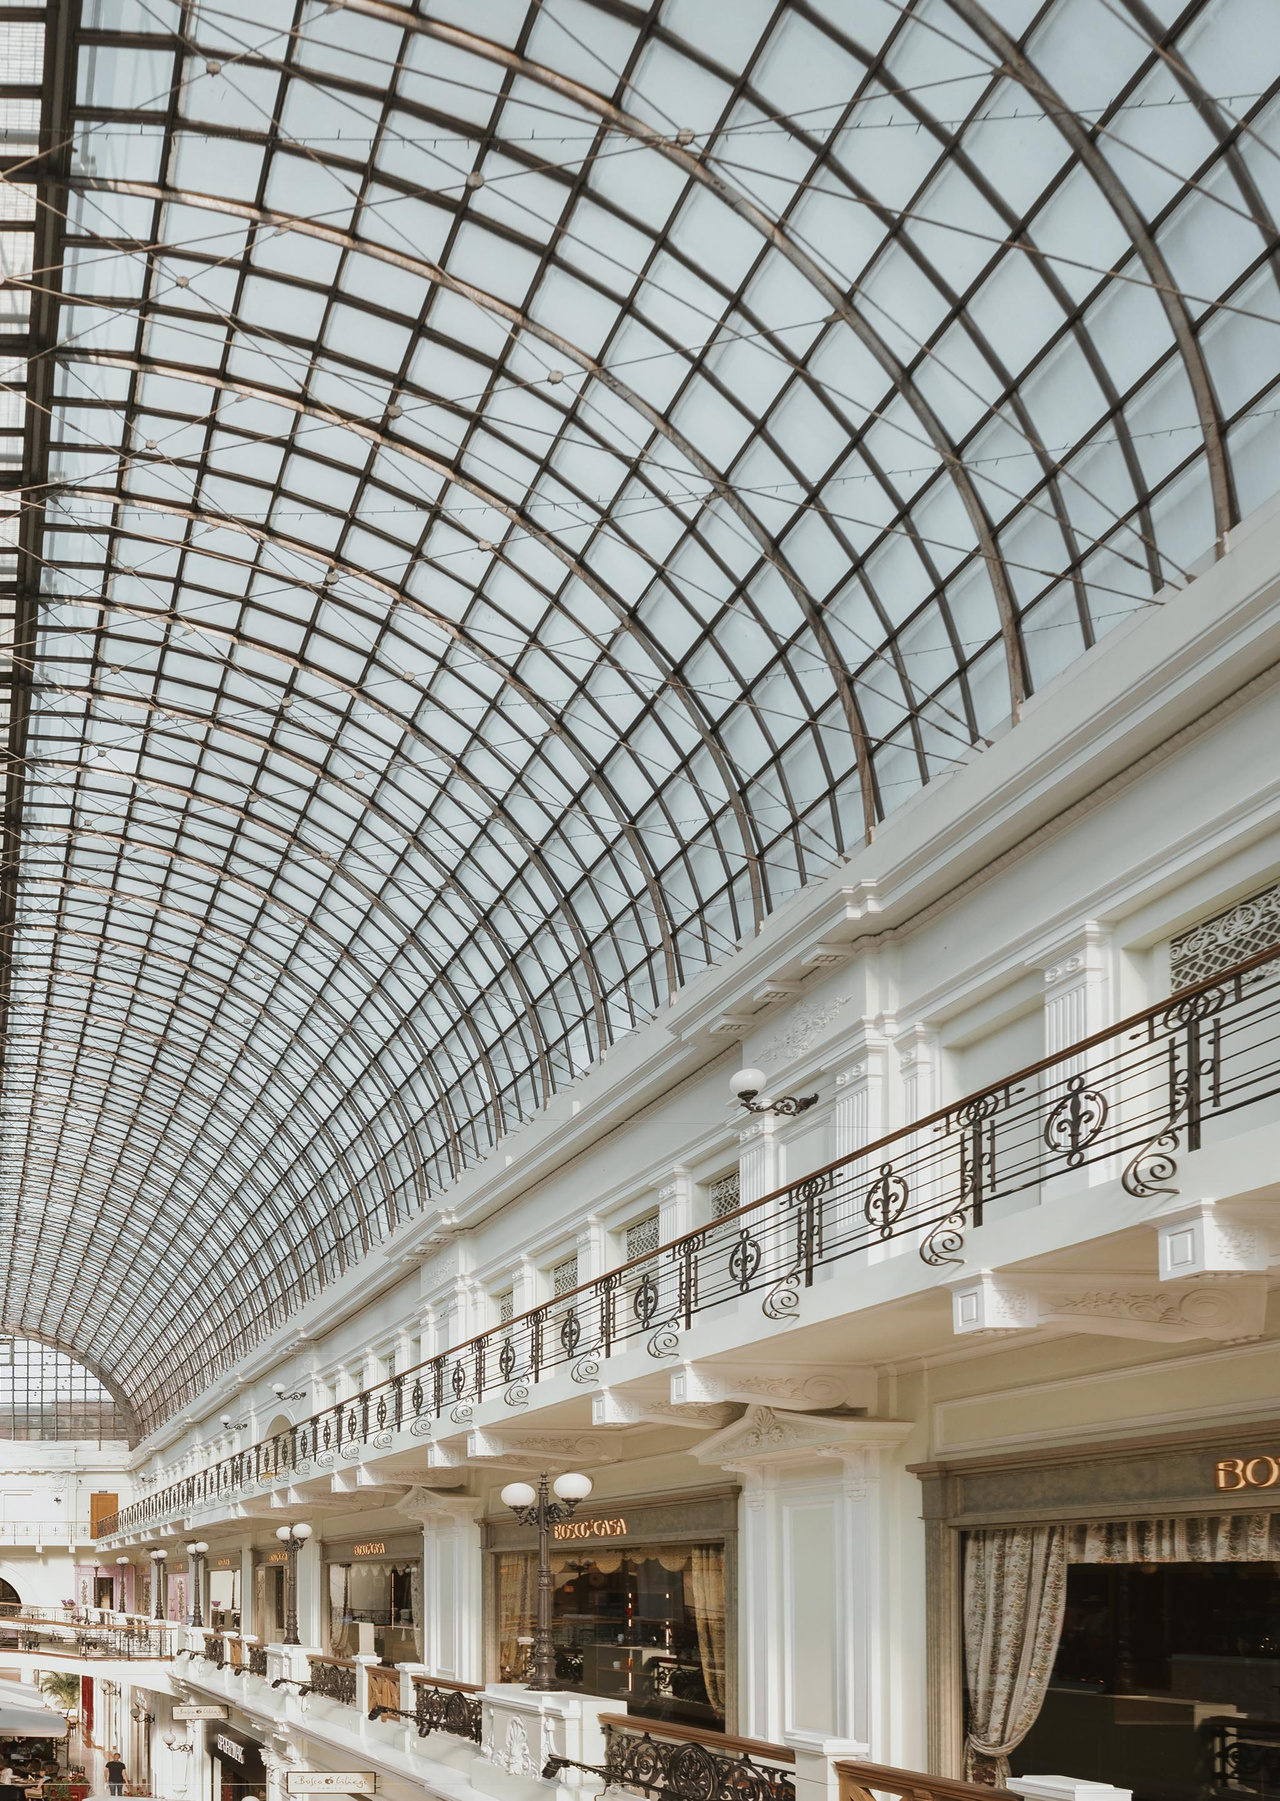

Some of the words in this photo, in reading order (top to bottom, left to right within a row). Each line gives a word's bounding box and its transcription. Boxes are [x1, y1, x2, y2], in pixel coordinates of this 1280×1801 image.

[1217, 1455, 1280, 1491] BO
[554, 1523, 590, 1540] BOSCO
[593, 1518, 627, 1537] CASA
